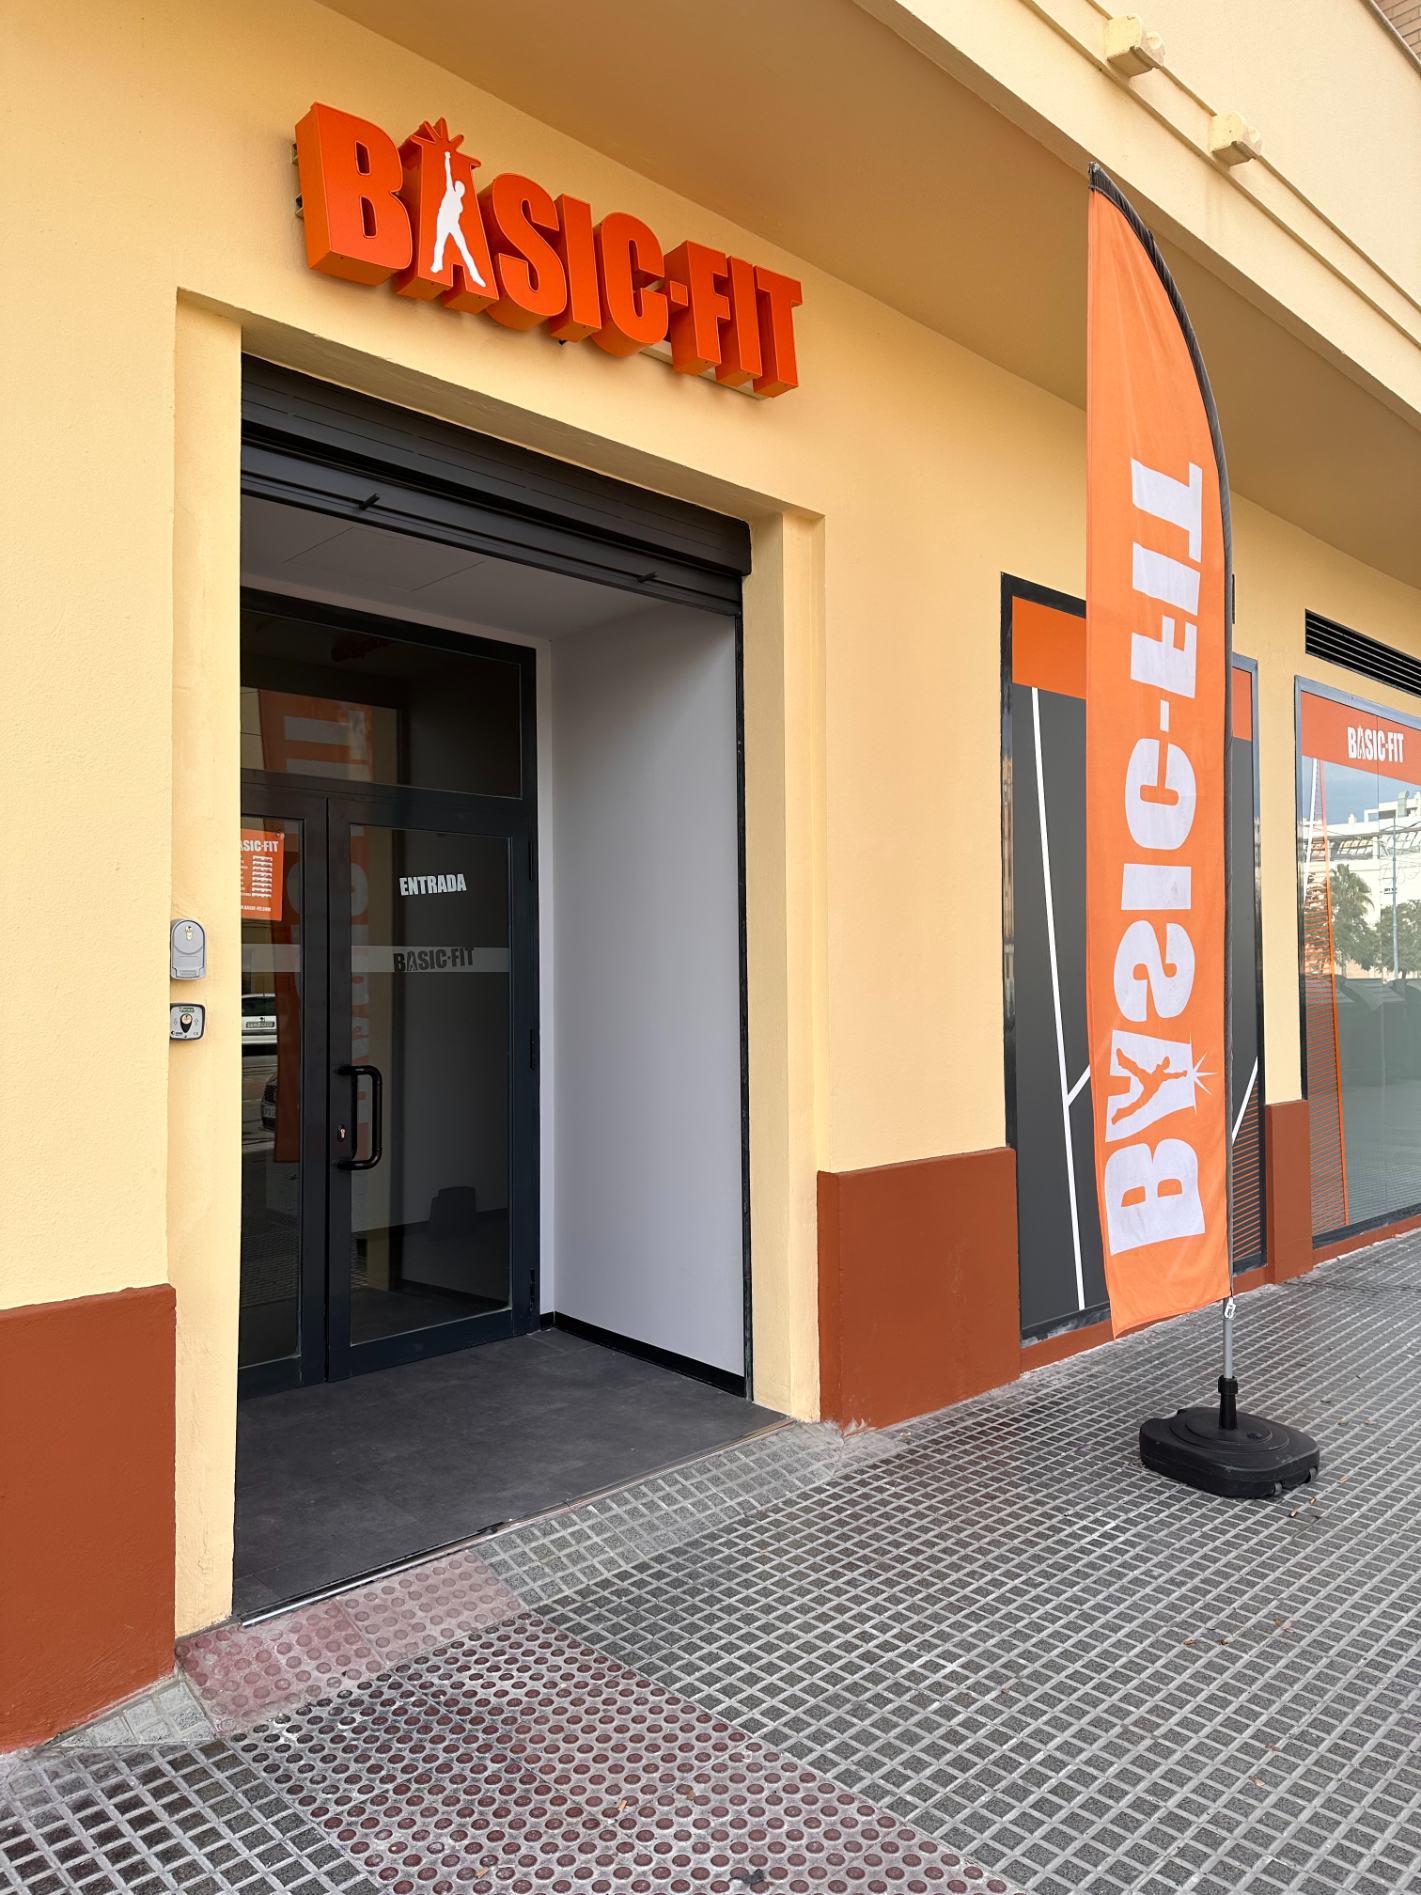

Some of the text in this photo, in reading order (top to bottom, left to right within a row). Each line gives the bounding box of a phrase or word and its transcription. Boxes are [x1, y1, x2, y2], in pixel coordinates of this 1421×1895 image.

[295, 102, 803, 397] BASIC-FIT
[240, 839, 279, 853] SIC-FIT
[399, 873, 467, 896] ENTRADA
